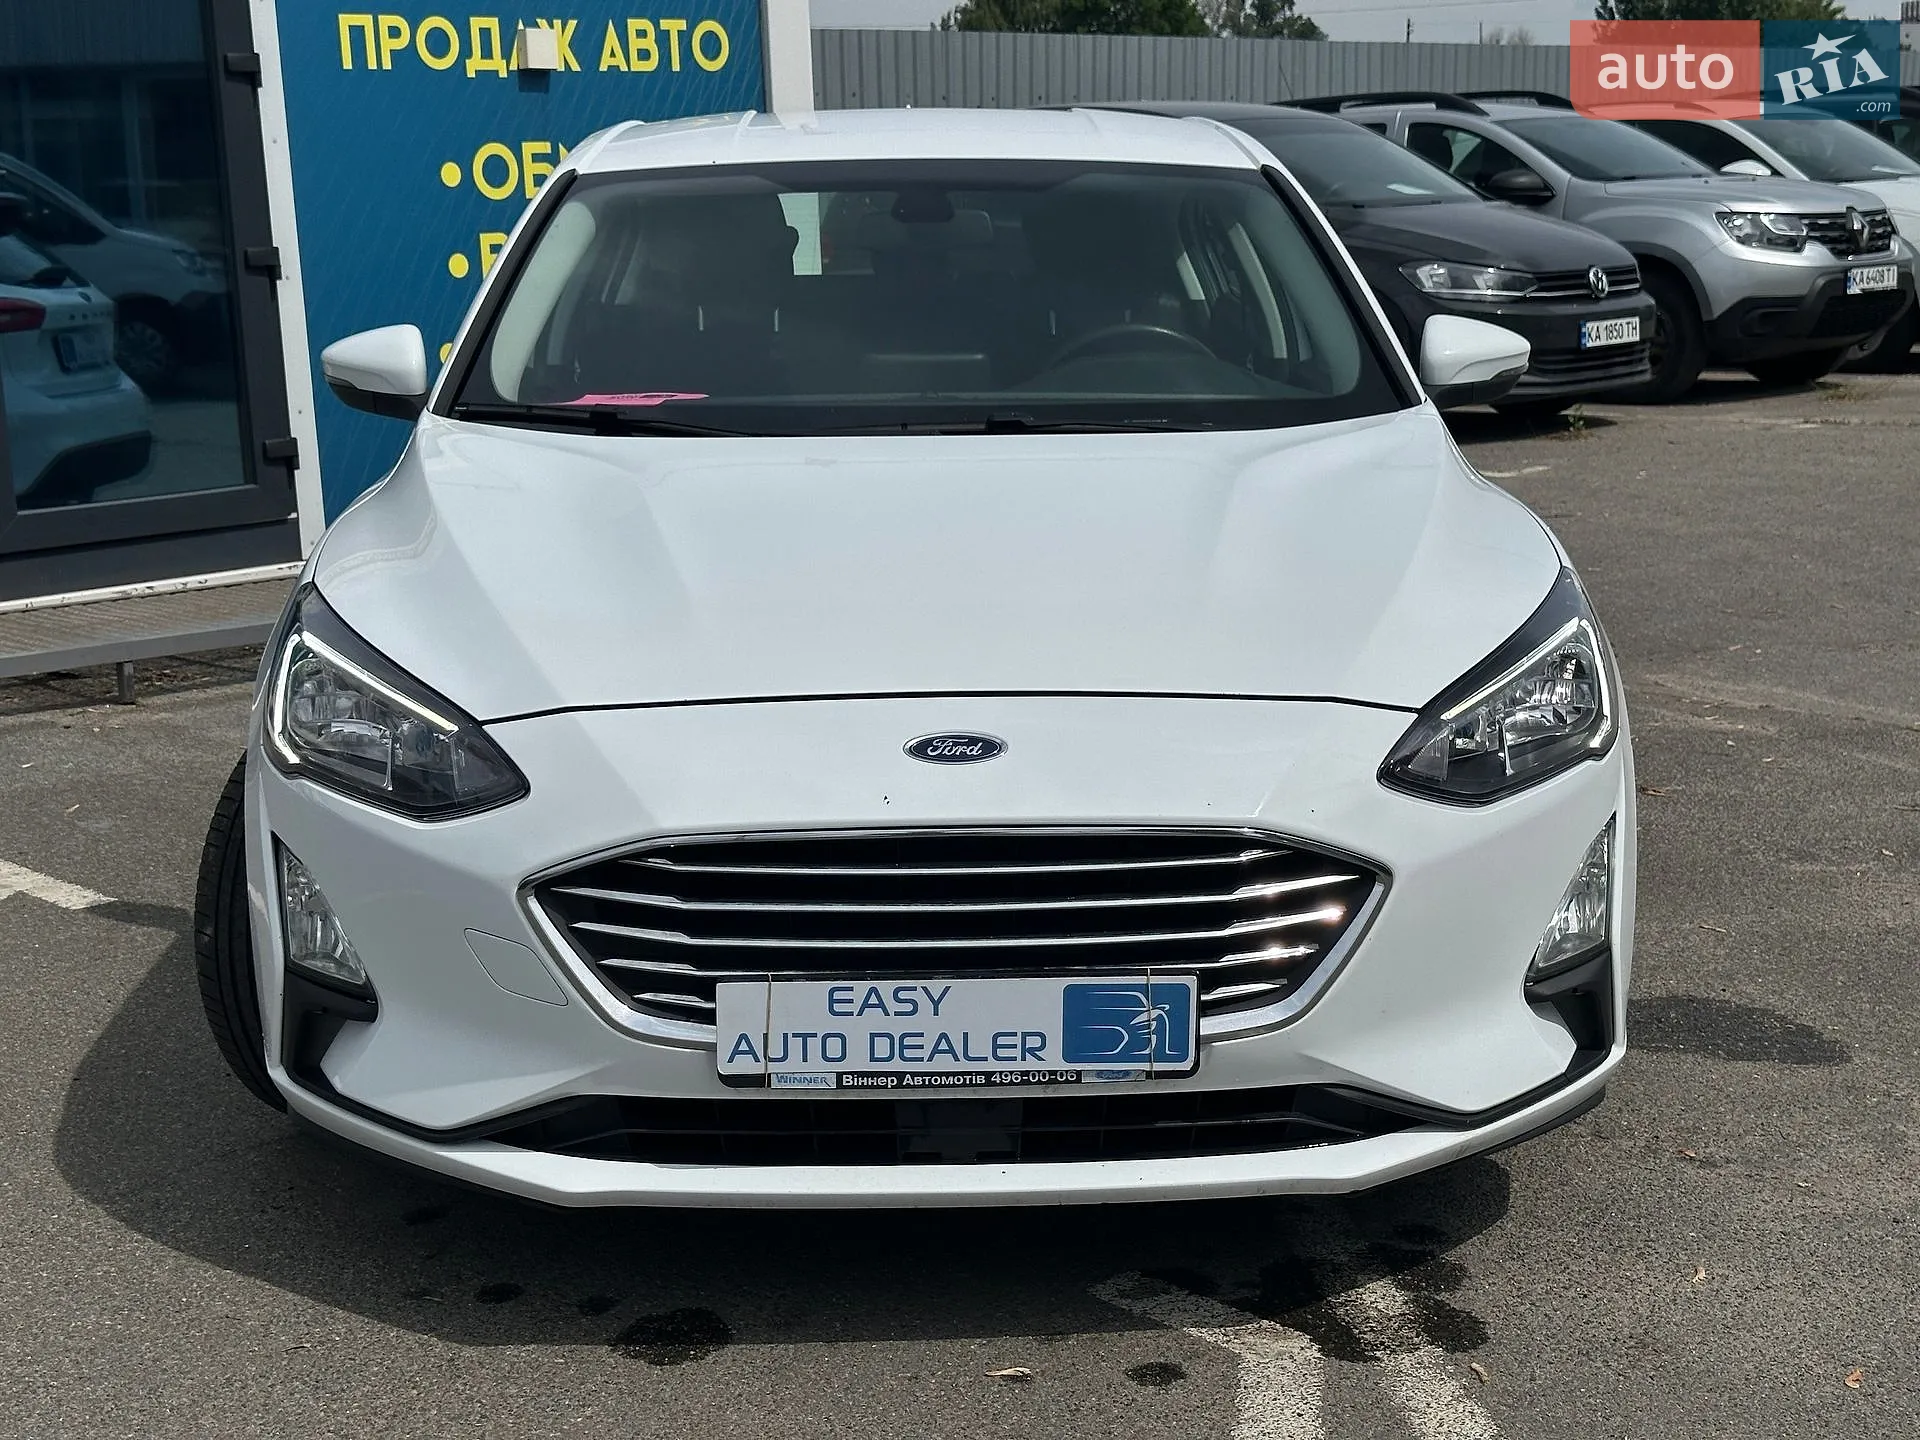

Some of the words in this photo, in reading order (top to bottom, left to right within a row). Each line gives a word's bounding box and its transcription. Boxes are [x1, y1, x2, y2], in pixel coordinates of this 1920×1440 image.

[599, 18, 731, 73] АВТО
[472, 141, 569, 201] ОБ
[1604, 322, 1624, 342] 1850
[926, 738, 983, 756] Ford
[826, 985, 952, 1017] EASY
[726, 1032, 848, 1064] AUTO
[868, 1030, 1048, 1064] DEALER
[842, 1074, 898, 1089] Віннер
[902, 1072, 986, 1086] Автомотів
[991, 1069, 1078, 1084] 496-00-06
